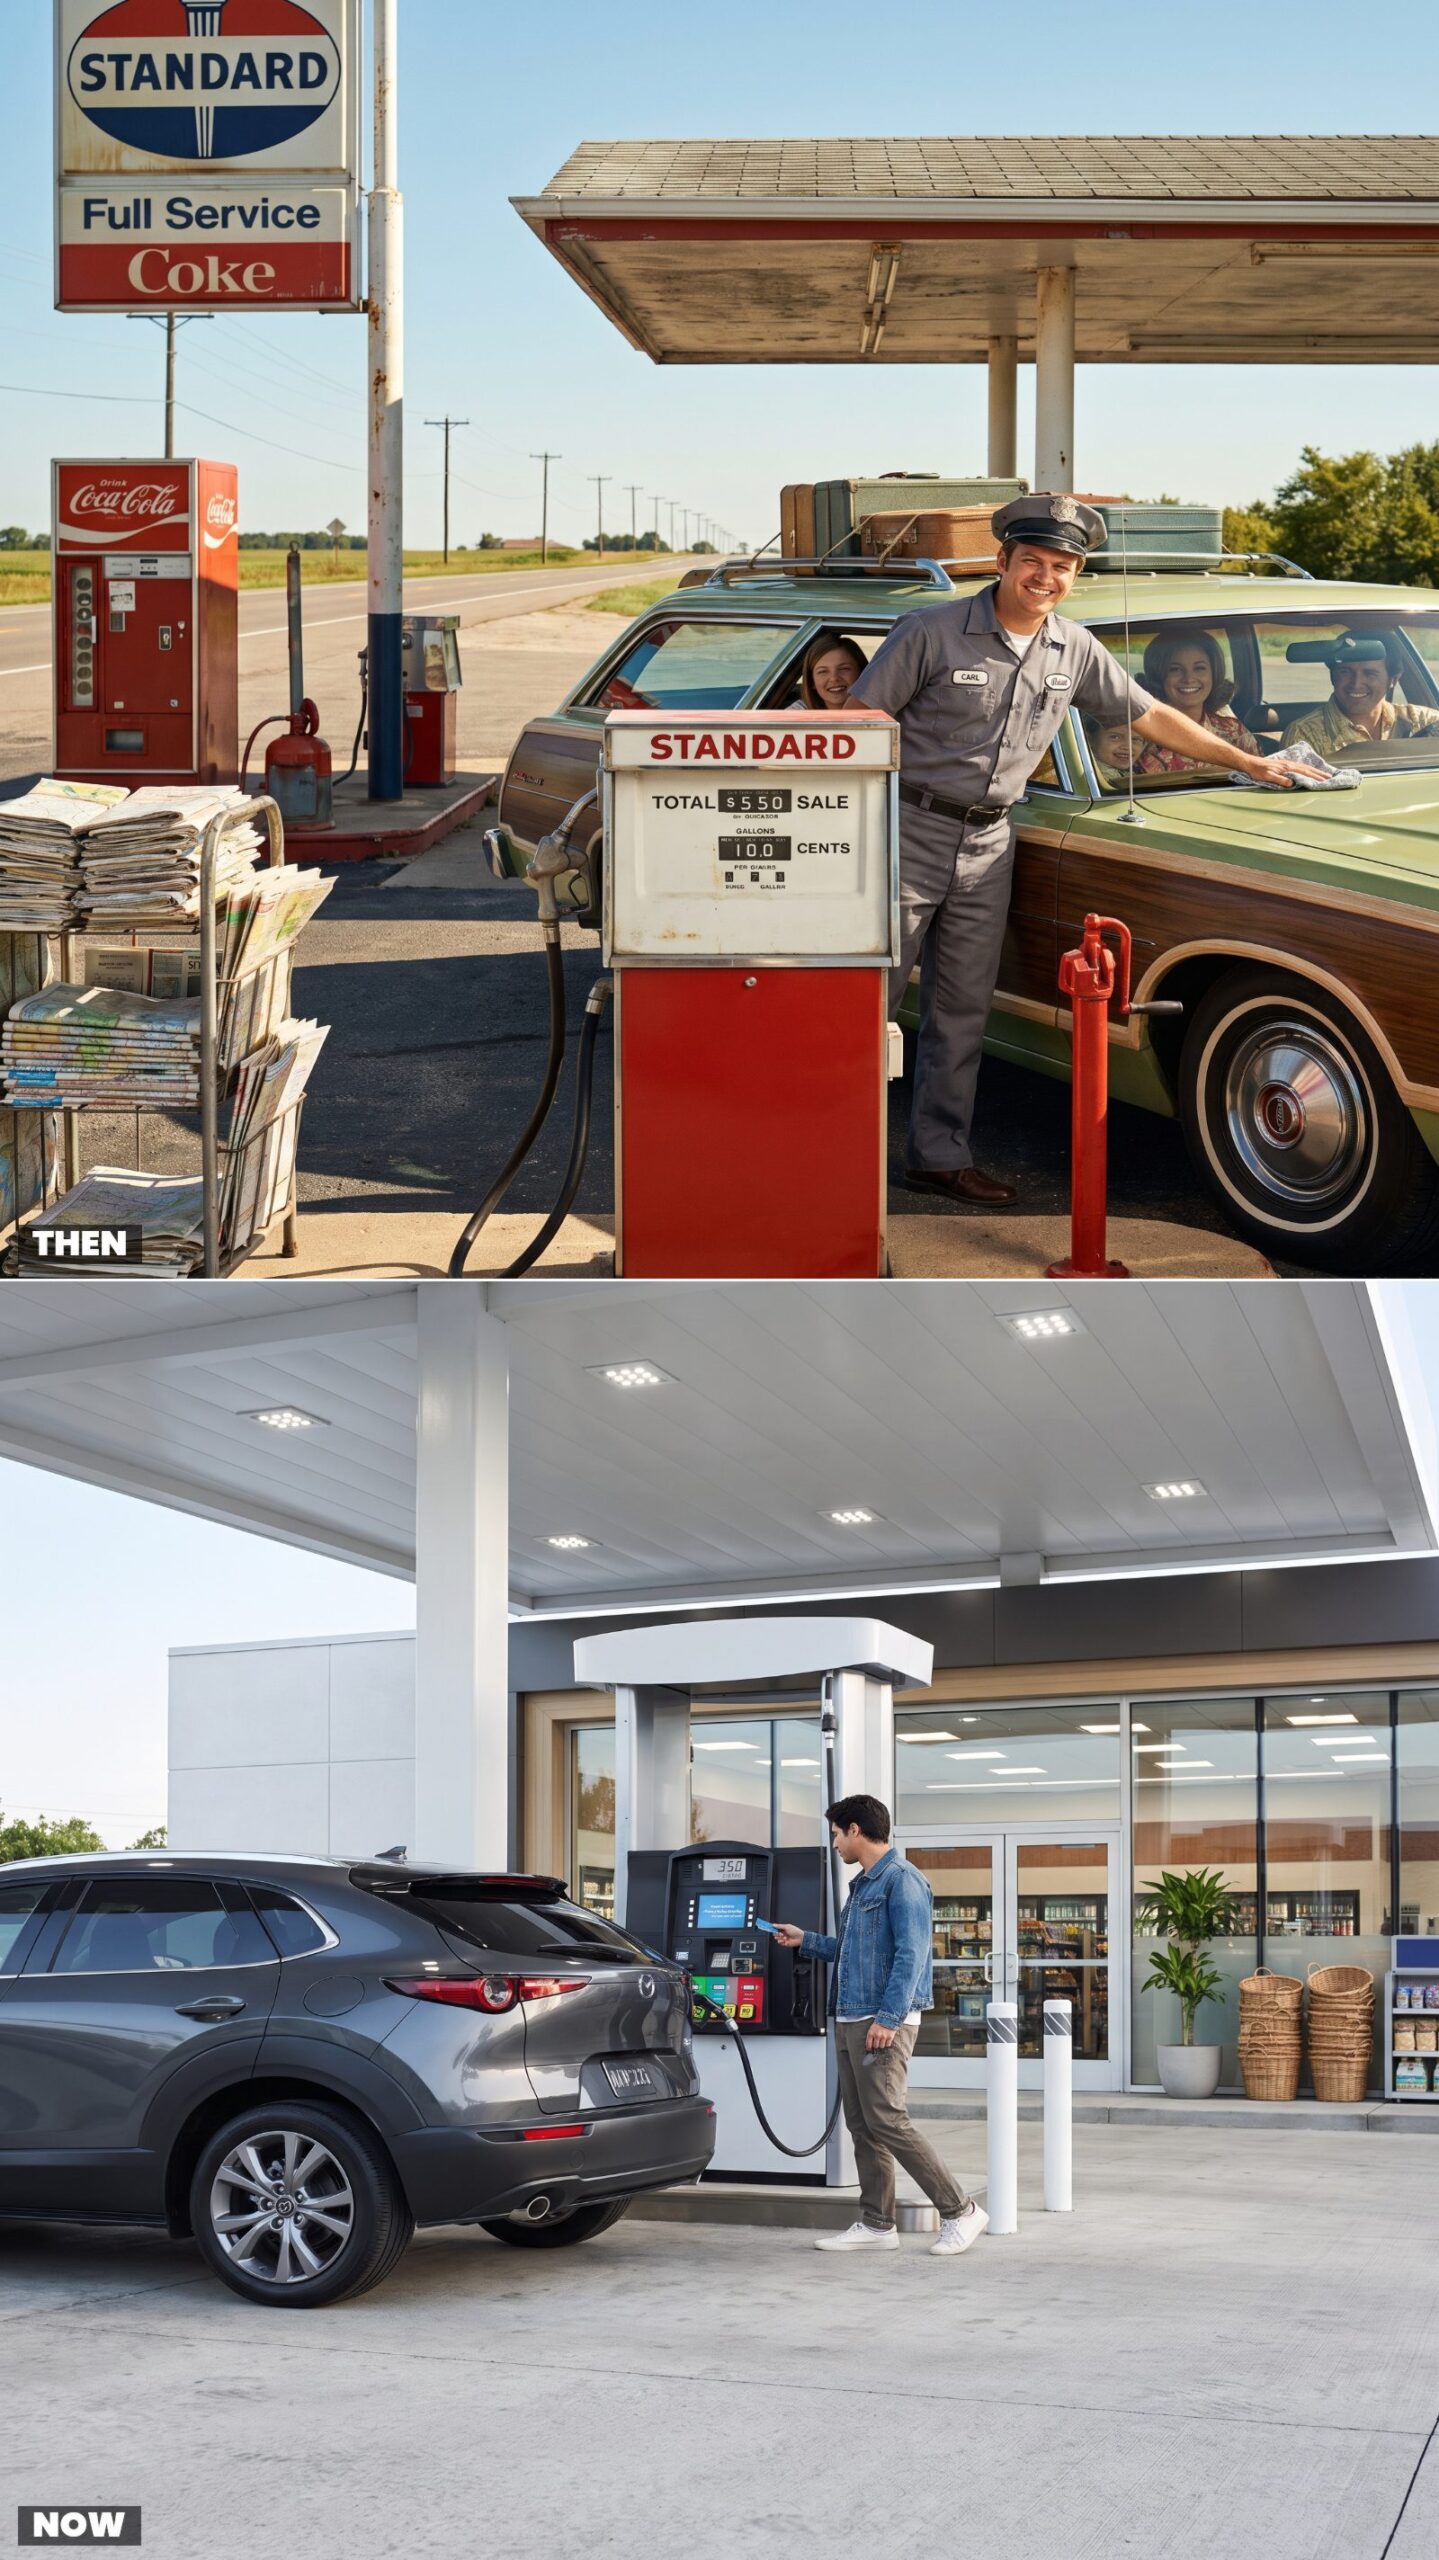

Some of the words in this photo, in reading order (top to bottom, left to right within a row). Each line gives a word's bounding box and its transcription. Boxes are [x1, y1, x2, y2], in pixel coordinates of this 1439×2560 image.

[80, 52, 328, 92] STANDARD
[83, 198, 152, 230] Full
[165, 196, 321, 230] Service
[128, 248, 276, 294] Coke
[100, 479, 128, 487] Drink
[69, 483, 180, 516] Coca-Cola
[961, 673, 980, 681] CARL
[650, 733, 857, 761] STANDARD
[651, 795, 716, 810] TOTAL
[796, 795, 849, 810] SALE
[736, 827, 776, 835] GALLONS
[796, 842, 851, 855] CENTS
